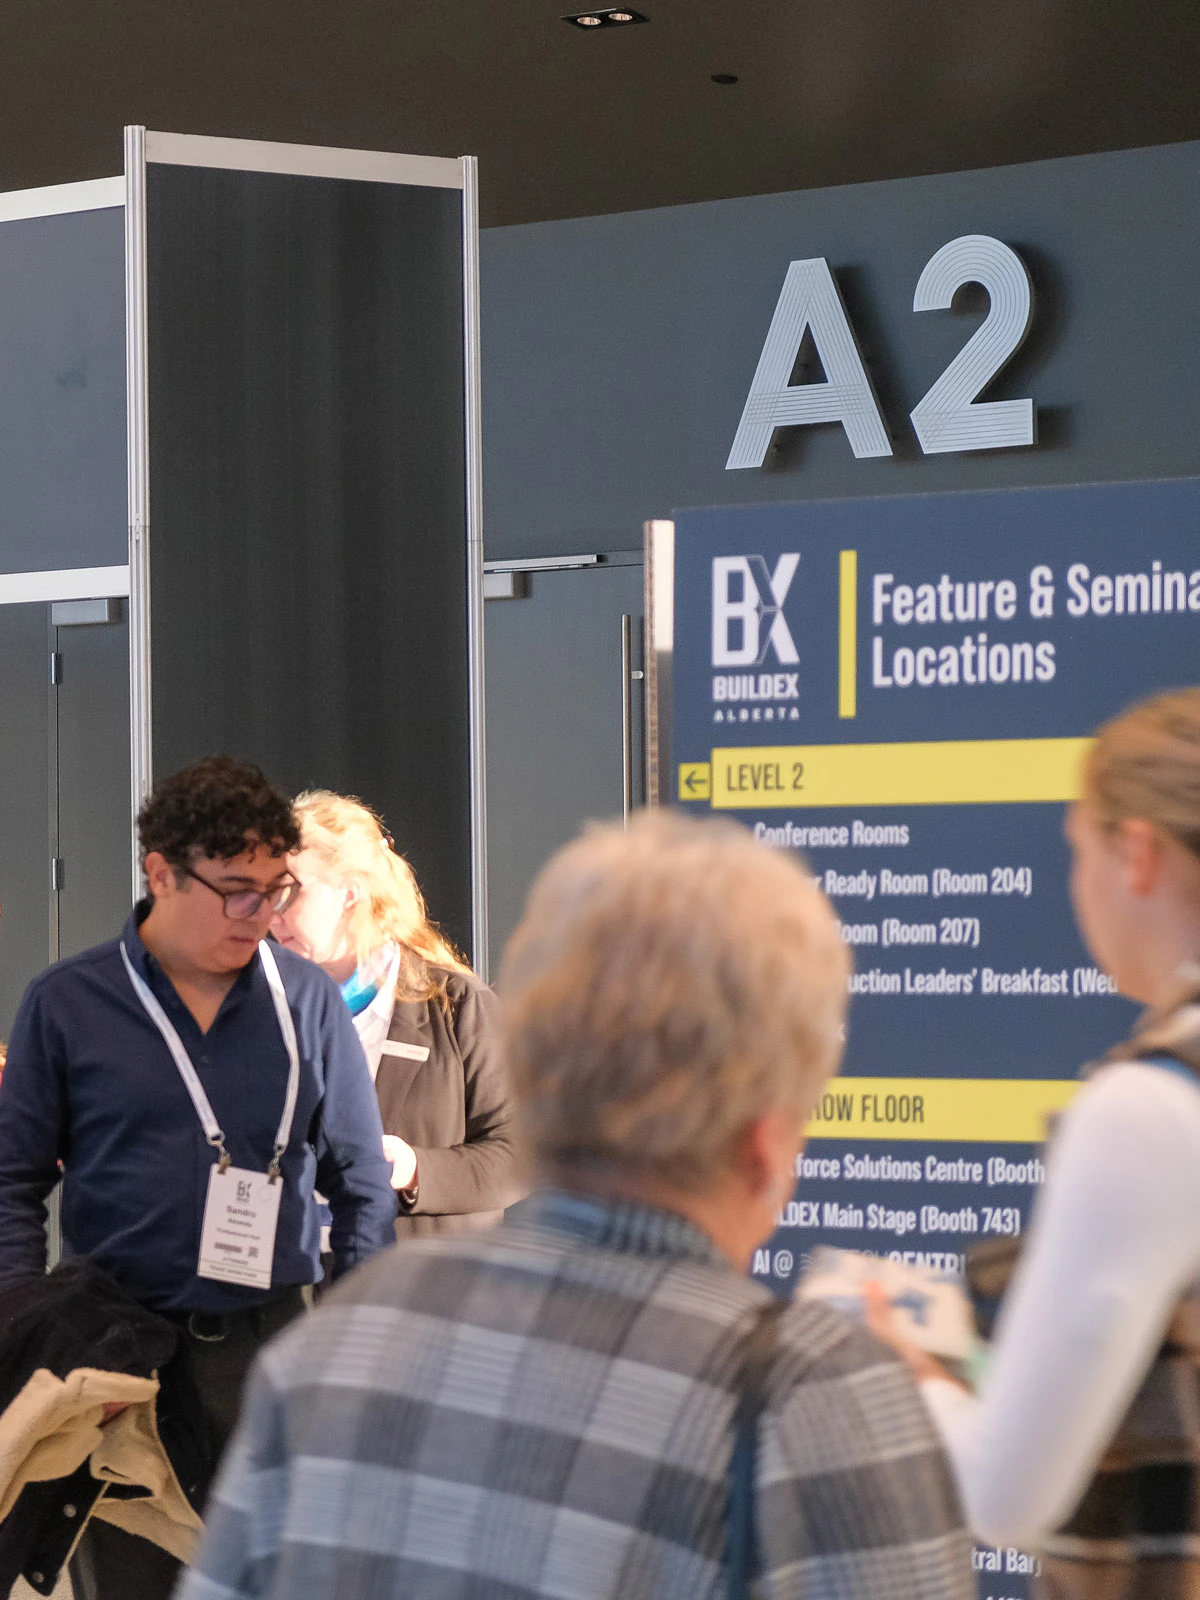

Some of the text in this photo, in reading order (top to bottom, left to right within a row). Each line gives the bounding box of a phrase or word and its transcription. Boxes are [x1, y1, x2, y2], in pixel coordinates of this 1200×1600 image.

[725, 234, 1036, 470] A2
[712, 552, 801, 668] BX
[873, 573, 1017, 626] Feature
[1029, 564, 1055, 618] &
[873, 632, 1056, 688] Locations
[712, 673, 799, 702] BUILDEX
[713, 706, 800, 723] ALBERTA
[726, 762, 804, 792] LEVEL 2
[753, 820, 909, 847] Conference Rooms
[824, 869, 876, 900] Ready
[880, 869, 928, 895] Room
[932, 868, 988, 897] (Room
[991, 867, 1033, 896] 204)
[881, 918, 936, 948] (Room
[940, 918, 980, 947] 207)
[847, 968, 901, 993] uction
[904, 967, 978, 994] Leaders’
[981, 967, 1068, 994] Breakfast
[861, 1094, 925, 1123] FLOOR
[794, 1152, 1045, 1186] force Solutions Centre (Booth
[823, 1202, 863, 1229] Main
[867, 1204, 917, 1236] Stage
[920, 1205, 978, 1234] (Booth
[981, 1207, 1021, 1237] 743)
[773, 1249, 794, 1279] @
[971, 1546, 1002, 1571] tral
